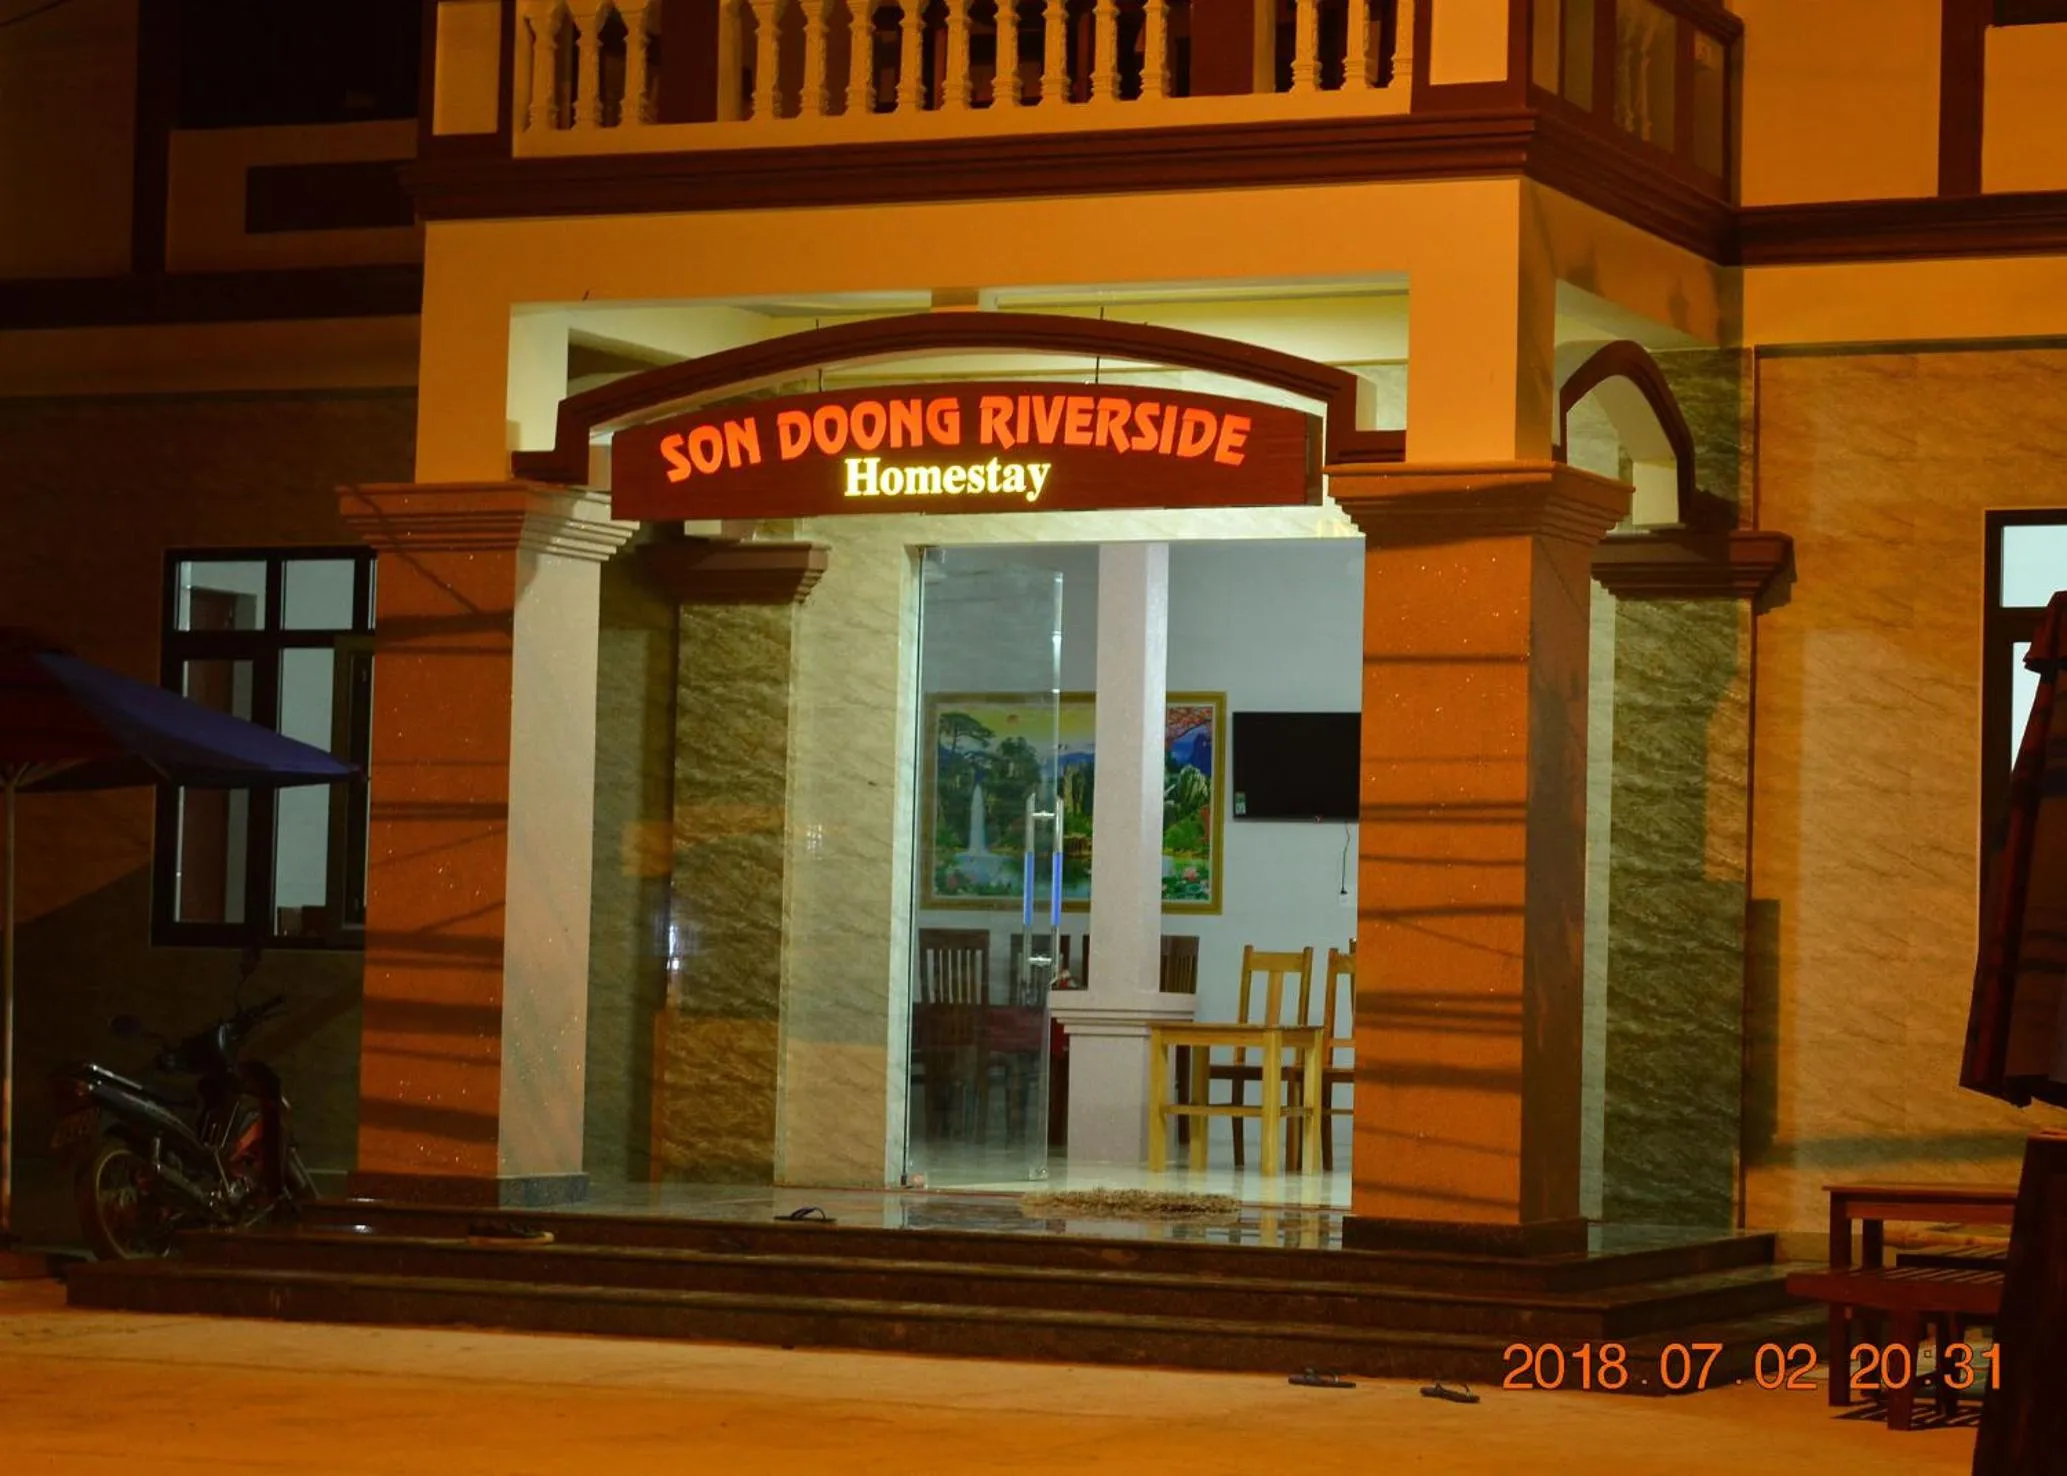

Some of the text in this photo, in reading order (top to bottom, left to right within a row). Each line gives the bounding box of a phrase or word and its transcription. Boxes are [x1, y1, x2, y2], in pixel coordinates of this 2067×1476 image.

[659, 394, 1253, 484] SON DOONG RIVERSIDE
[843, 456, 1053, 503] Homestay
